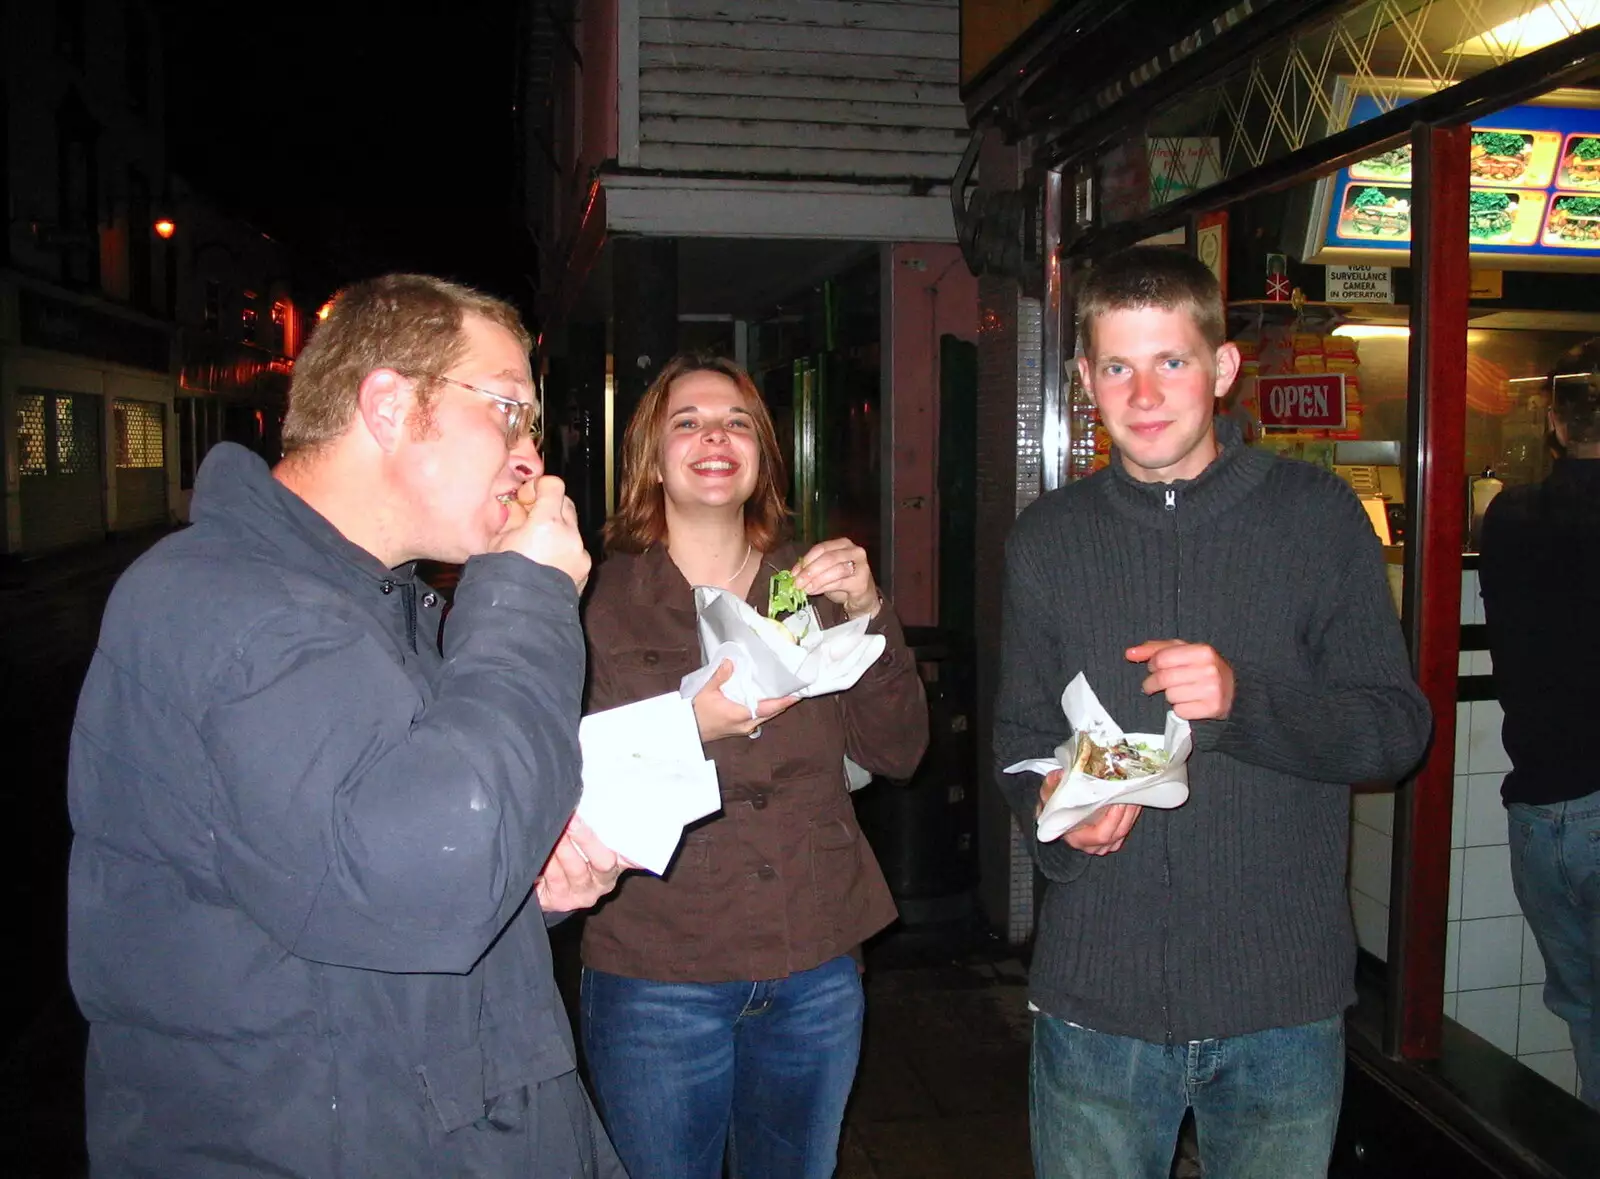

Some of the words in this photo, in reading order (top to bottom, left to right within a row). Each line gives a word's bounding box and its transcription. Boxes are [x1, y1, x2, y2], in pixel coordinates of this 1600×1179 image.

[1330, 272, 1387, 281] SURVEILLANCE
[1343, 282, 1376, 290] CAMERA
[1269, 385, 1329, 418] OPEN
